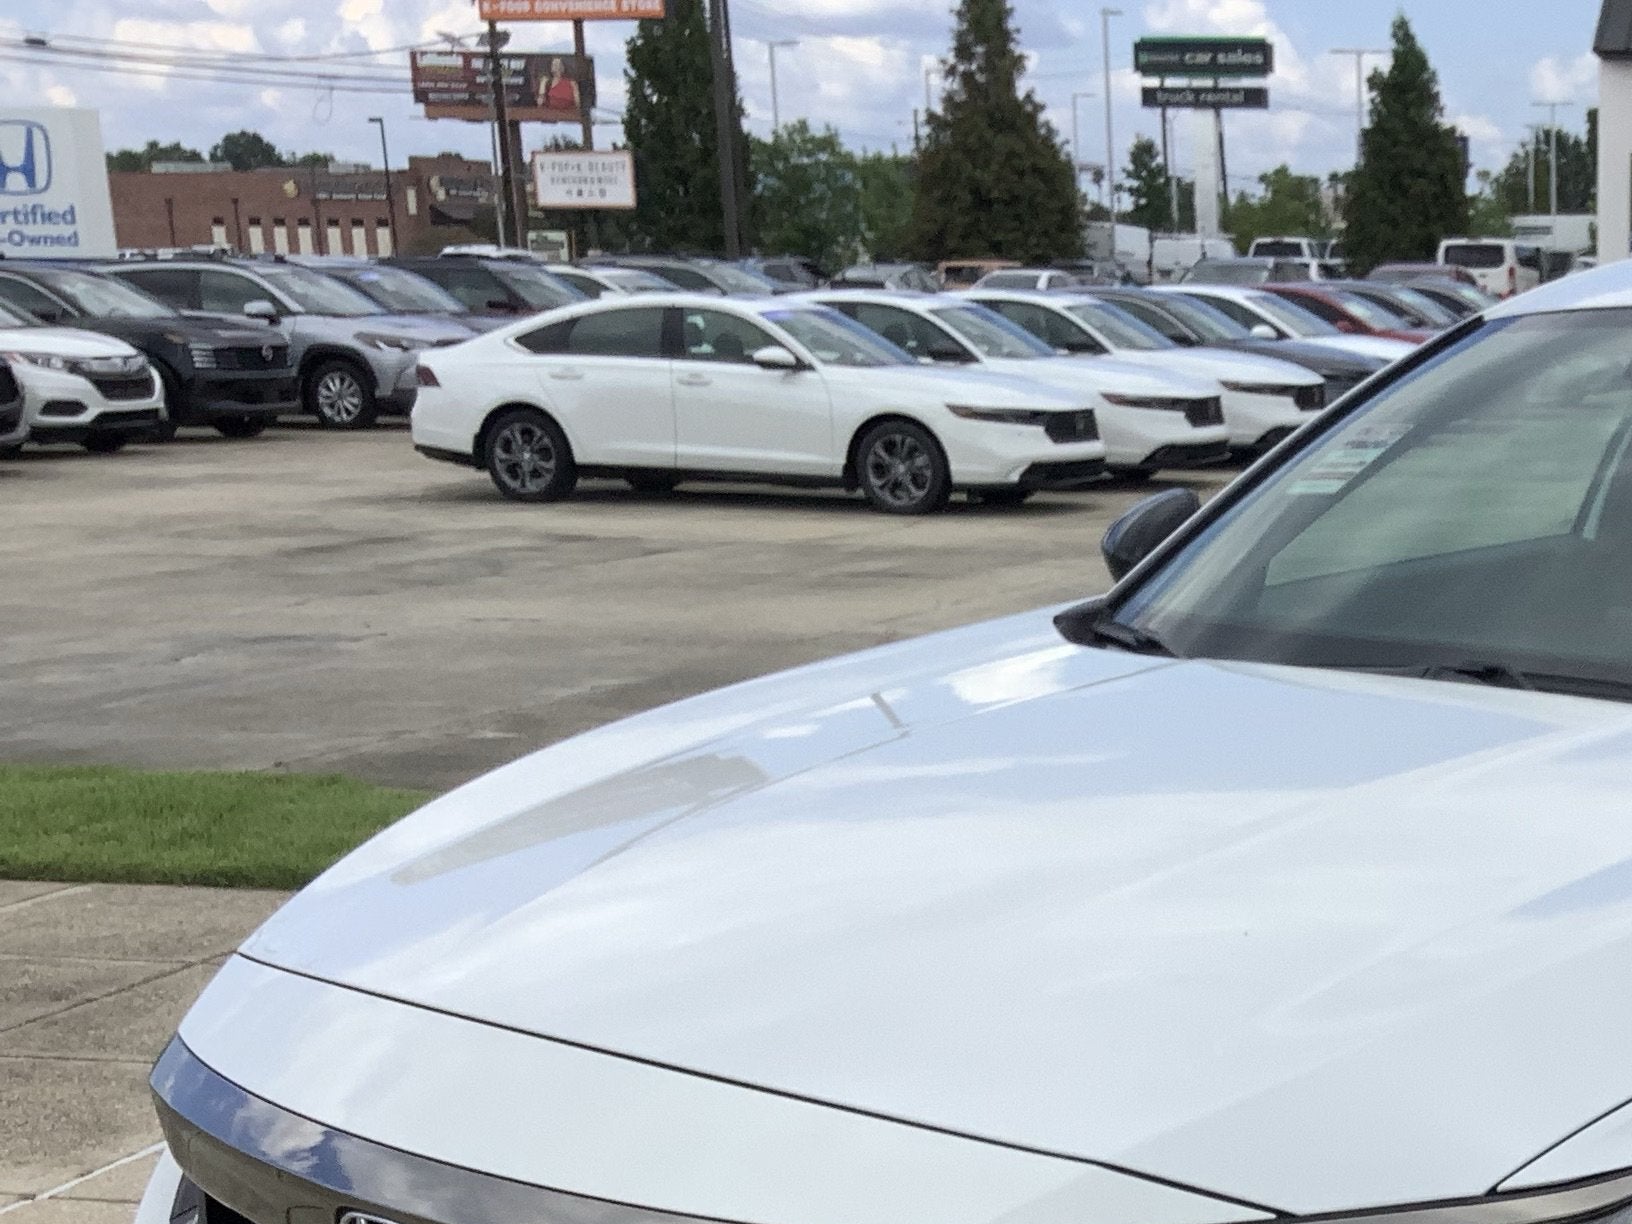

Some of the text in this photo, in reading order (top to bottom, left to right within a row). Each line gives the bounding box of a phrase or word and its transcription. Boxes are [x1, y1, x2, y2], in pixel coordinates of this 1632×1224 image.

[534, 0, 617, 13] CONVENIENCE
[620, 0, 662, 13] STORE
[1184, 52, 1213, 65] car
[1216, 48, 1265, 65] sales
[1156, 89, 1246, 104] truck rental
